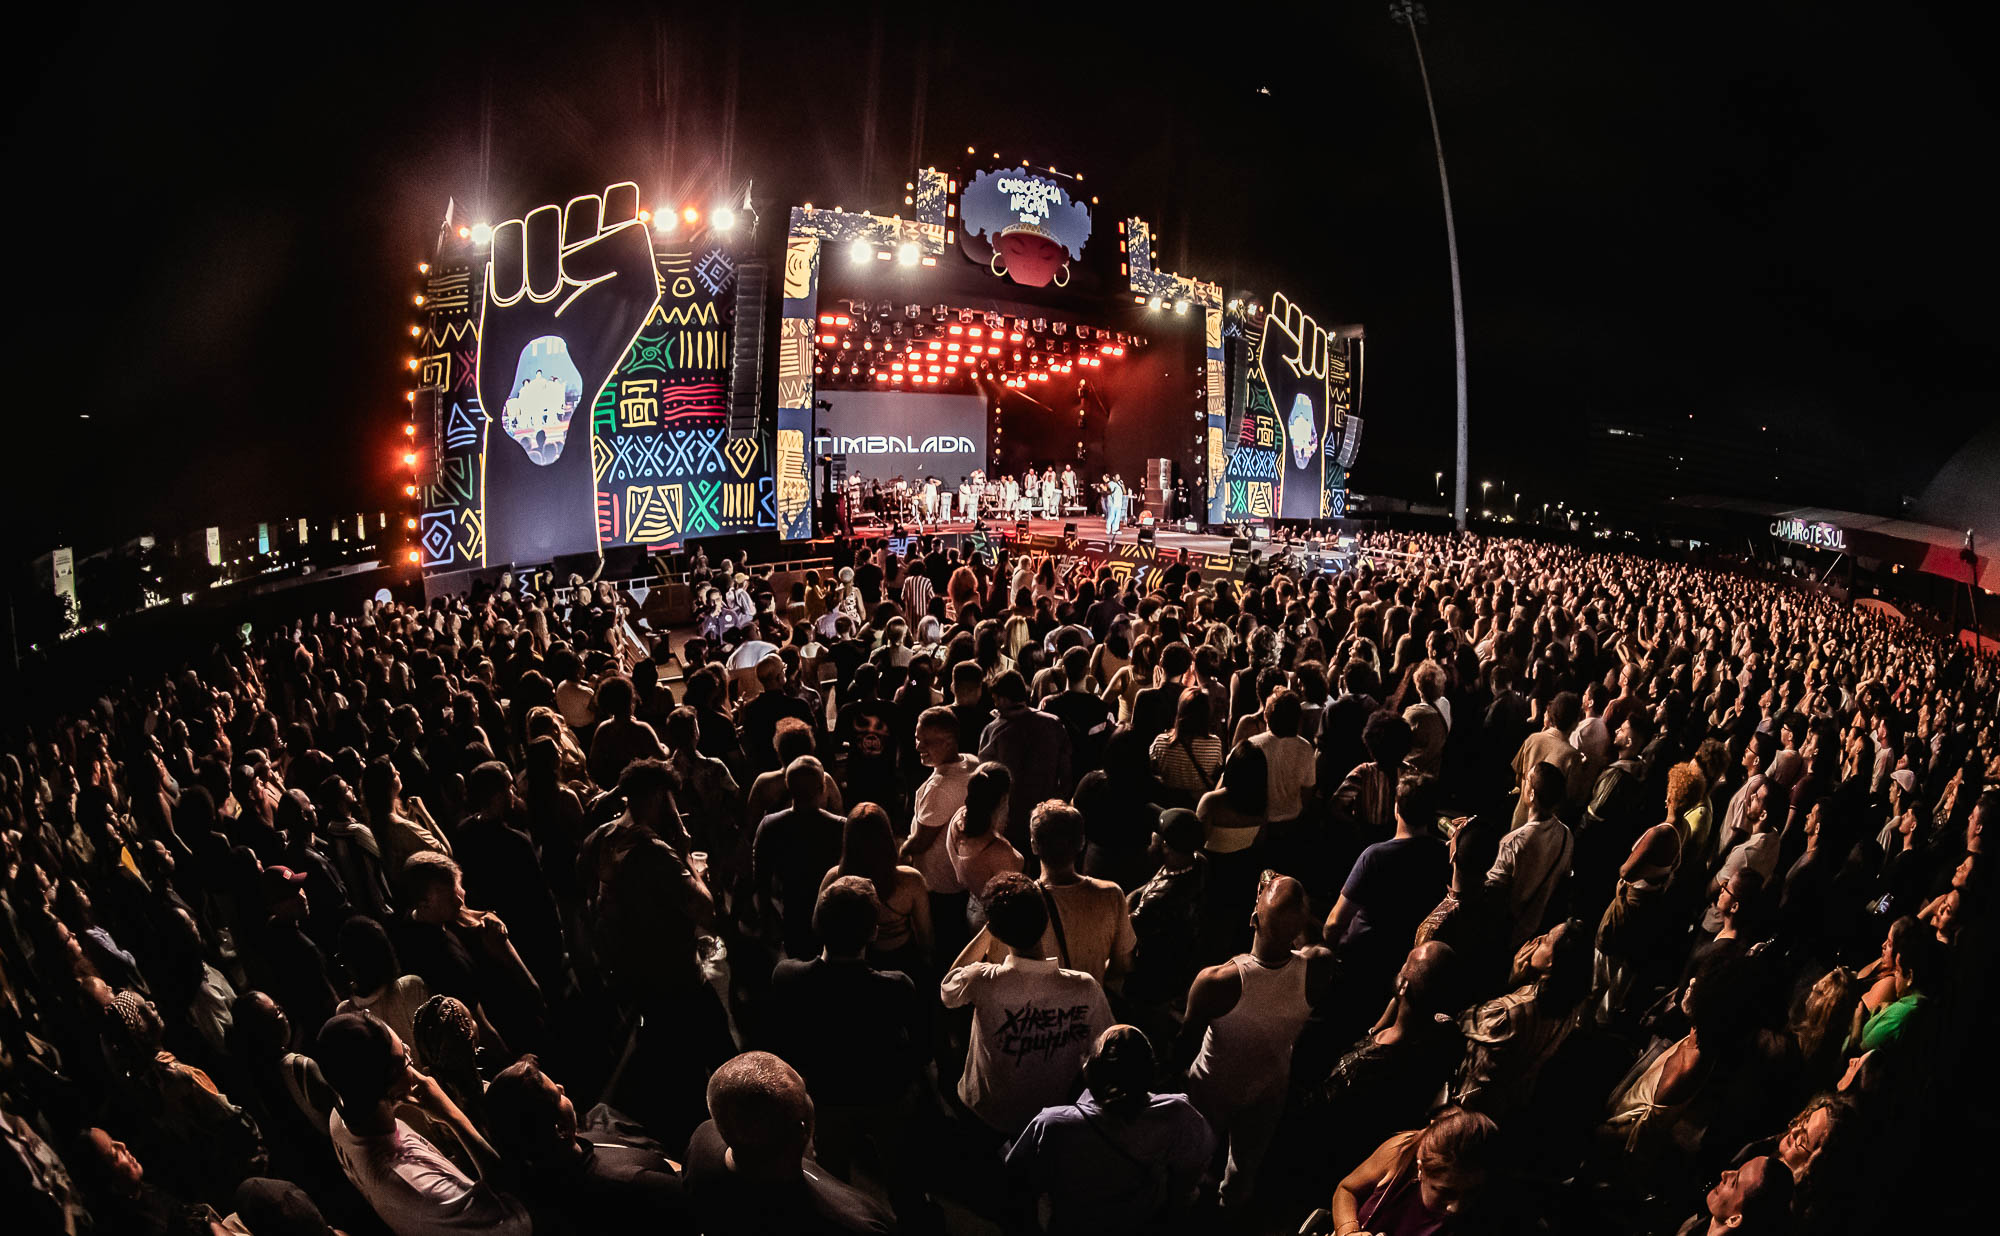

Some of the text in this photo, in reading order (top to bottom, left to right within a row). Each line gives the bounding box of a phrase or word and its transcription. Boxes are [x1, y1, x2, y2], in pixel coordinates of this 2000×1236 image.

[1011, 193, 1049, 218] NEGRA
[814, 435, 976, 454] TIMBALADA
[1823, 527, 1847, 549] SUL
[992, 1000, 1089, 1035] XTREME
